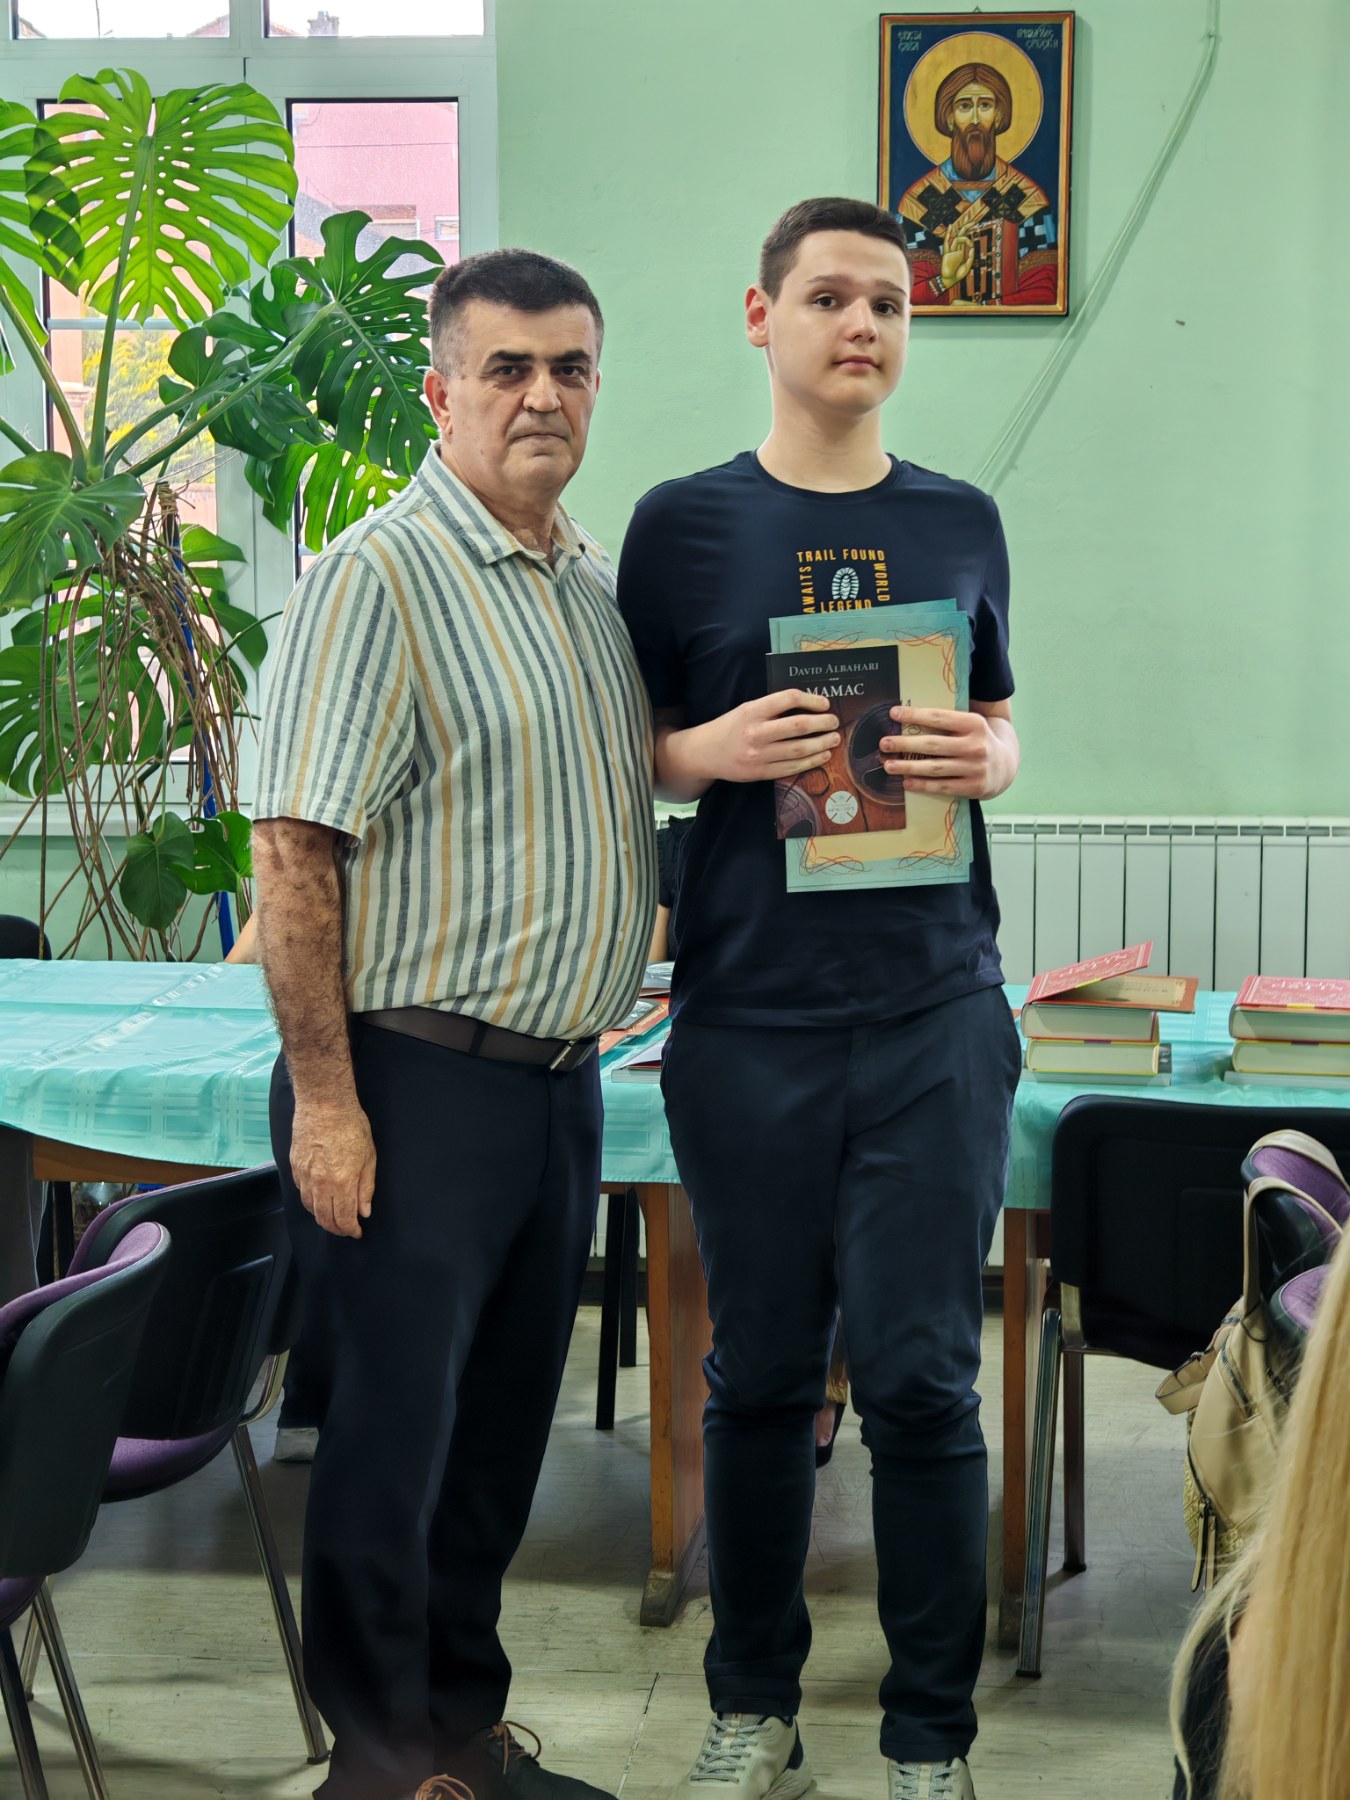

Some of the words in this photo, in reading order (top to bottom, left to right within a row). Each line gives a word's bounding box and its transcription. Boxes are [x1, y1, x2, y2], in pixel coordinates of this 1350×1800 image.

[796, 548, 836, 562] TRAIL
[842, 548, 885, 561] FOUND
[799, 565, 816, 613] AWAITS
[873, 562, 890, 601] WORLD
[820, 599, 873, 613] LEGEND
